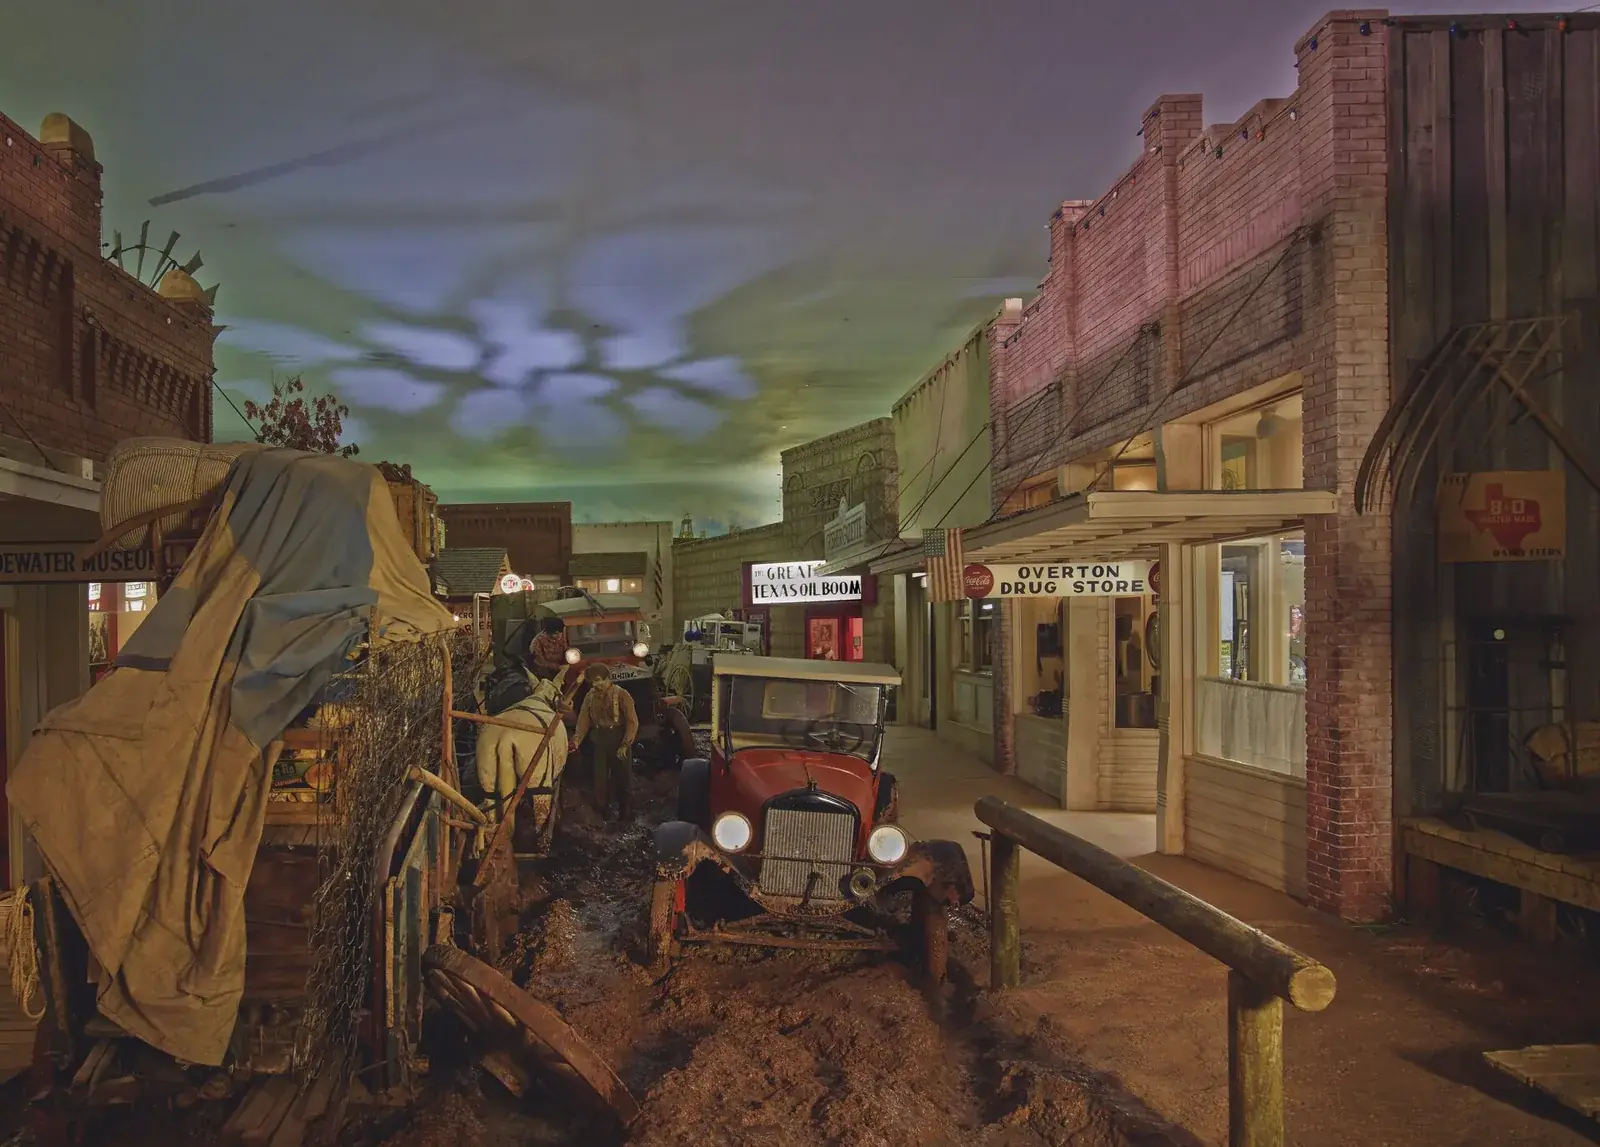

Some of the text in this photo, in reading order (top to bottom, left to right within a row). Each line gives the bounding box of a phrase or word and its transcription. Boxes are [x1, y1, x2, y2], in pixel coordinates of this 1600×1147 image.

[82, 549, 155, 572] MUSEU
[767, 564, 812, 580] GREAT
[1018, 565, 1120, 579] OVERTON
[753, 580, 861, 599] TEXAS OIL BOOM
[1001, 580, 1144, 595] DRUG STORE
